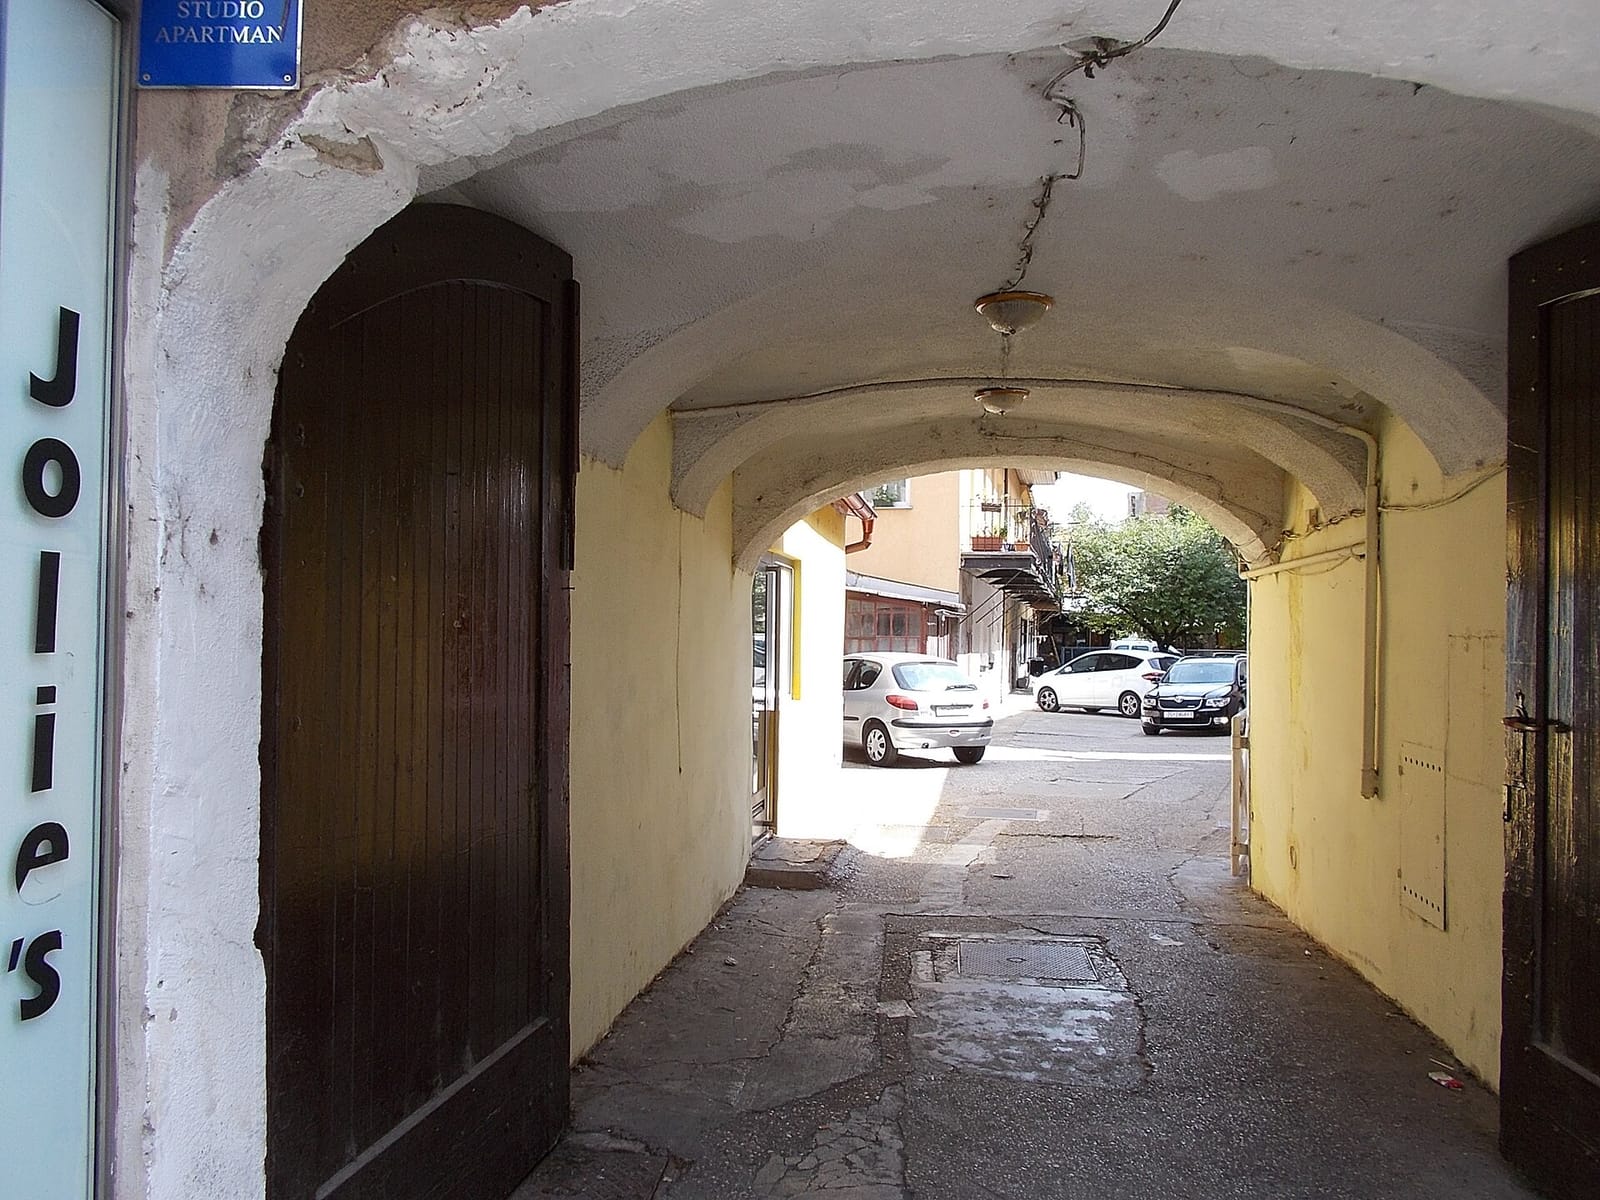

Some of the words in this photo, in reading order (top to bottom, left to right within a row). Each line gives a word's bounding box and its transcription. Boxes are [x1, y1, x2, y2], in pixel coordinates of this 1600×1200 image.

[177, 0, 264, 19] STUDIO
[155, 25, 283, 44] APARTMAN
[8, 306, 81, 1022] Jolie's
